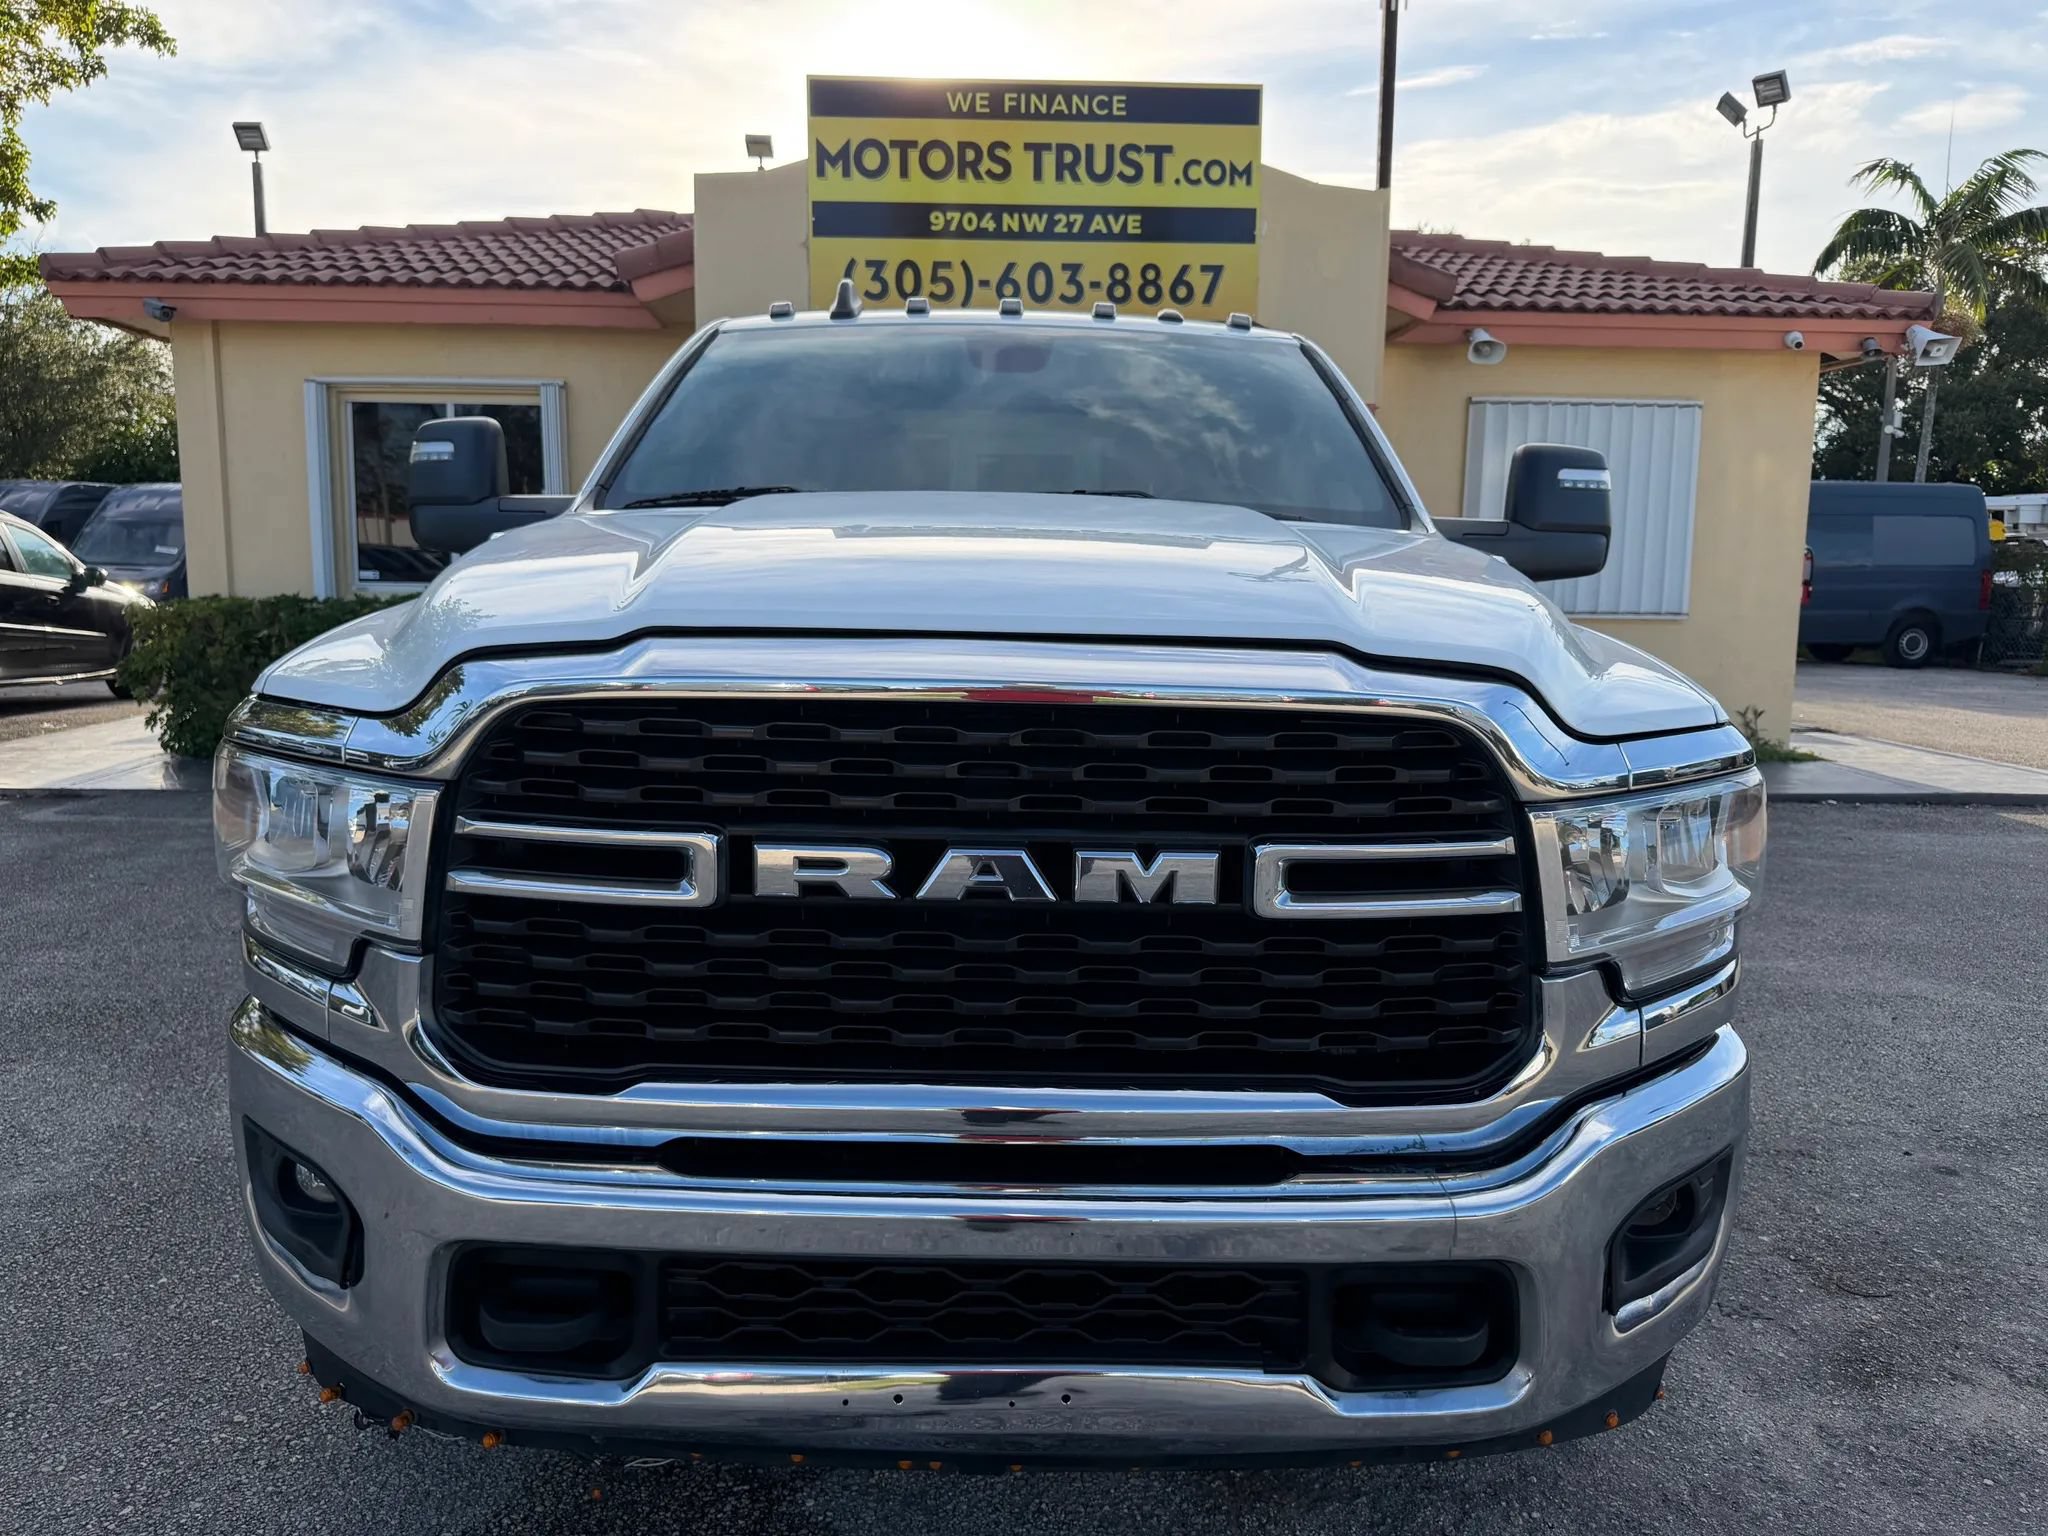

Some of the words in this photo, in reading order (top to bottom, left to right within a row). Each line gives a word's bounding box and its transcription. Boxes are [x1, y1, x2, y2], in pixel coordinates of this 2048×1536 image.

[946, 91, 990, 112] WE
[1004, 93, 1127, 115] FINANCE
[816, 138, 1012, 183] MOTORS
[930, 211, 997, 232] 9704
[1002, 213, 1048, 232] NW
[1053, 214, 1084, 234] 27
[1089, 214, 1142, 234] AVE
[753, 844, 1221, 905] RAM
